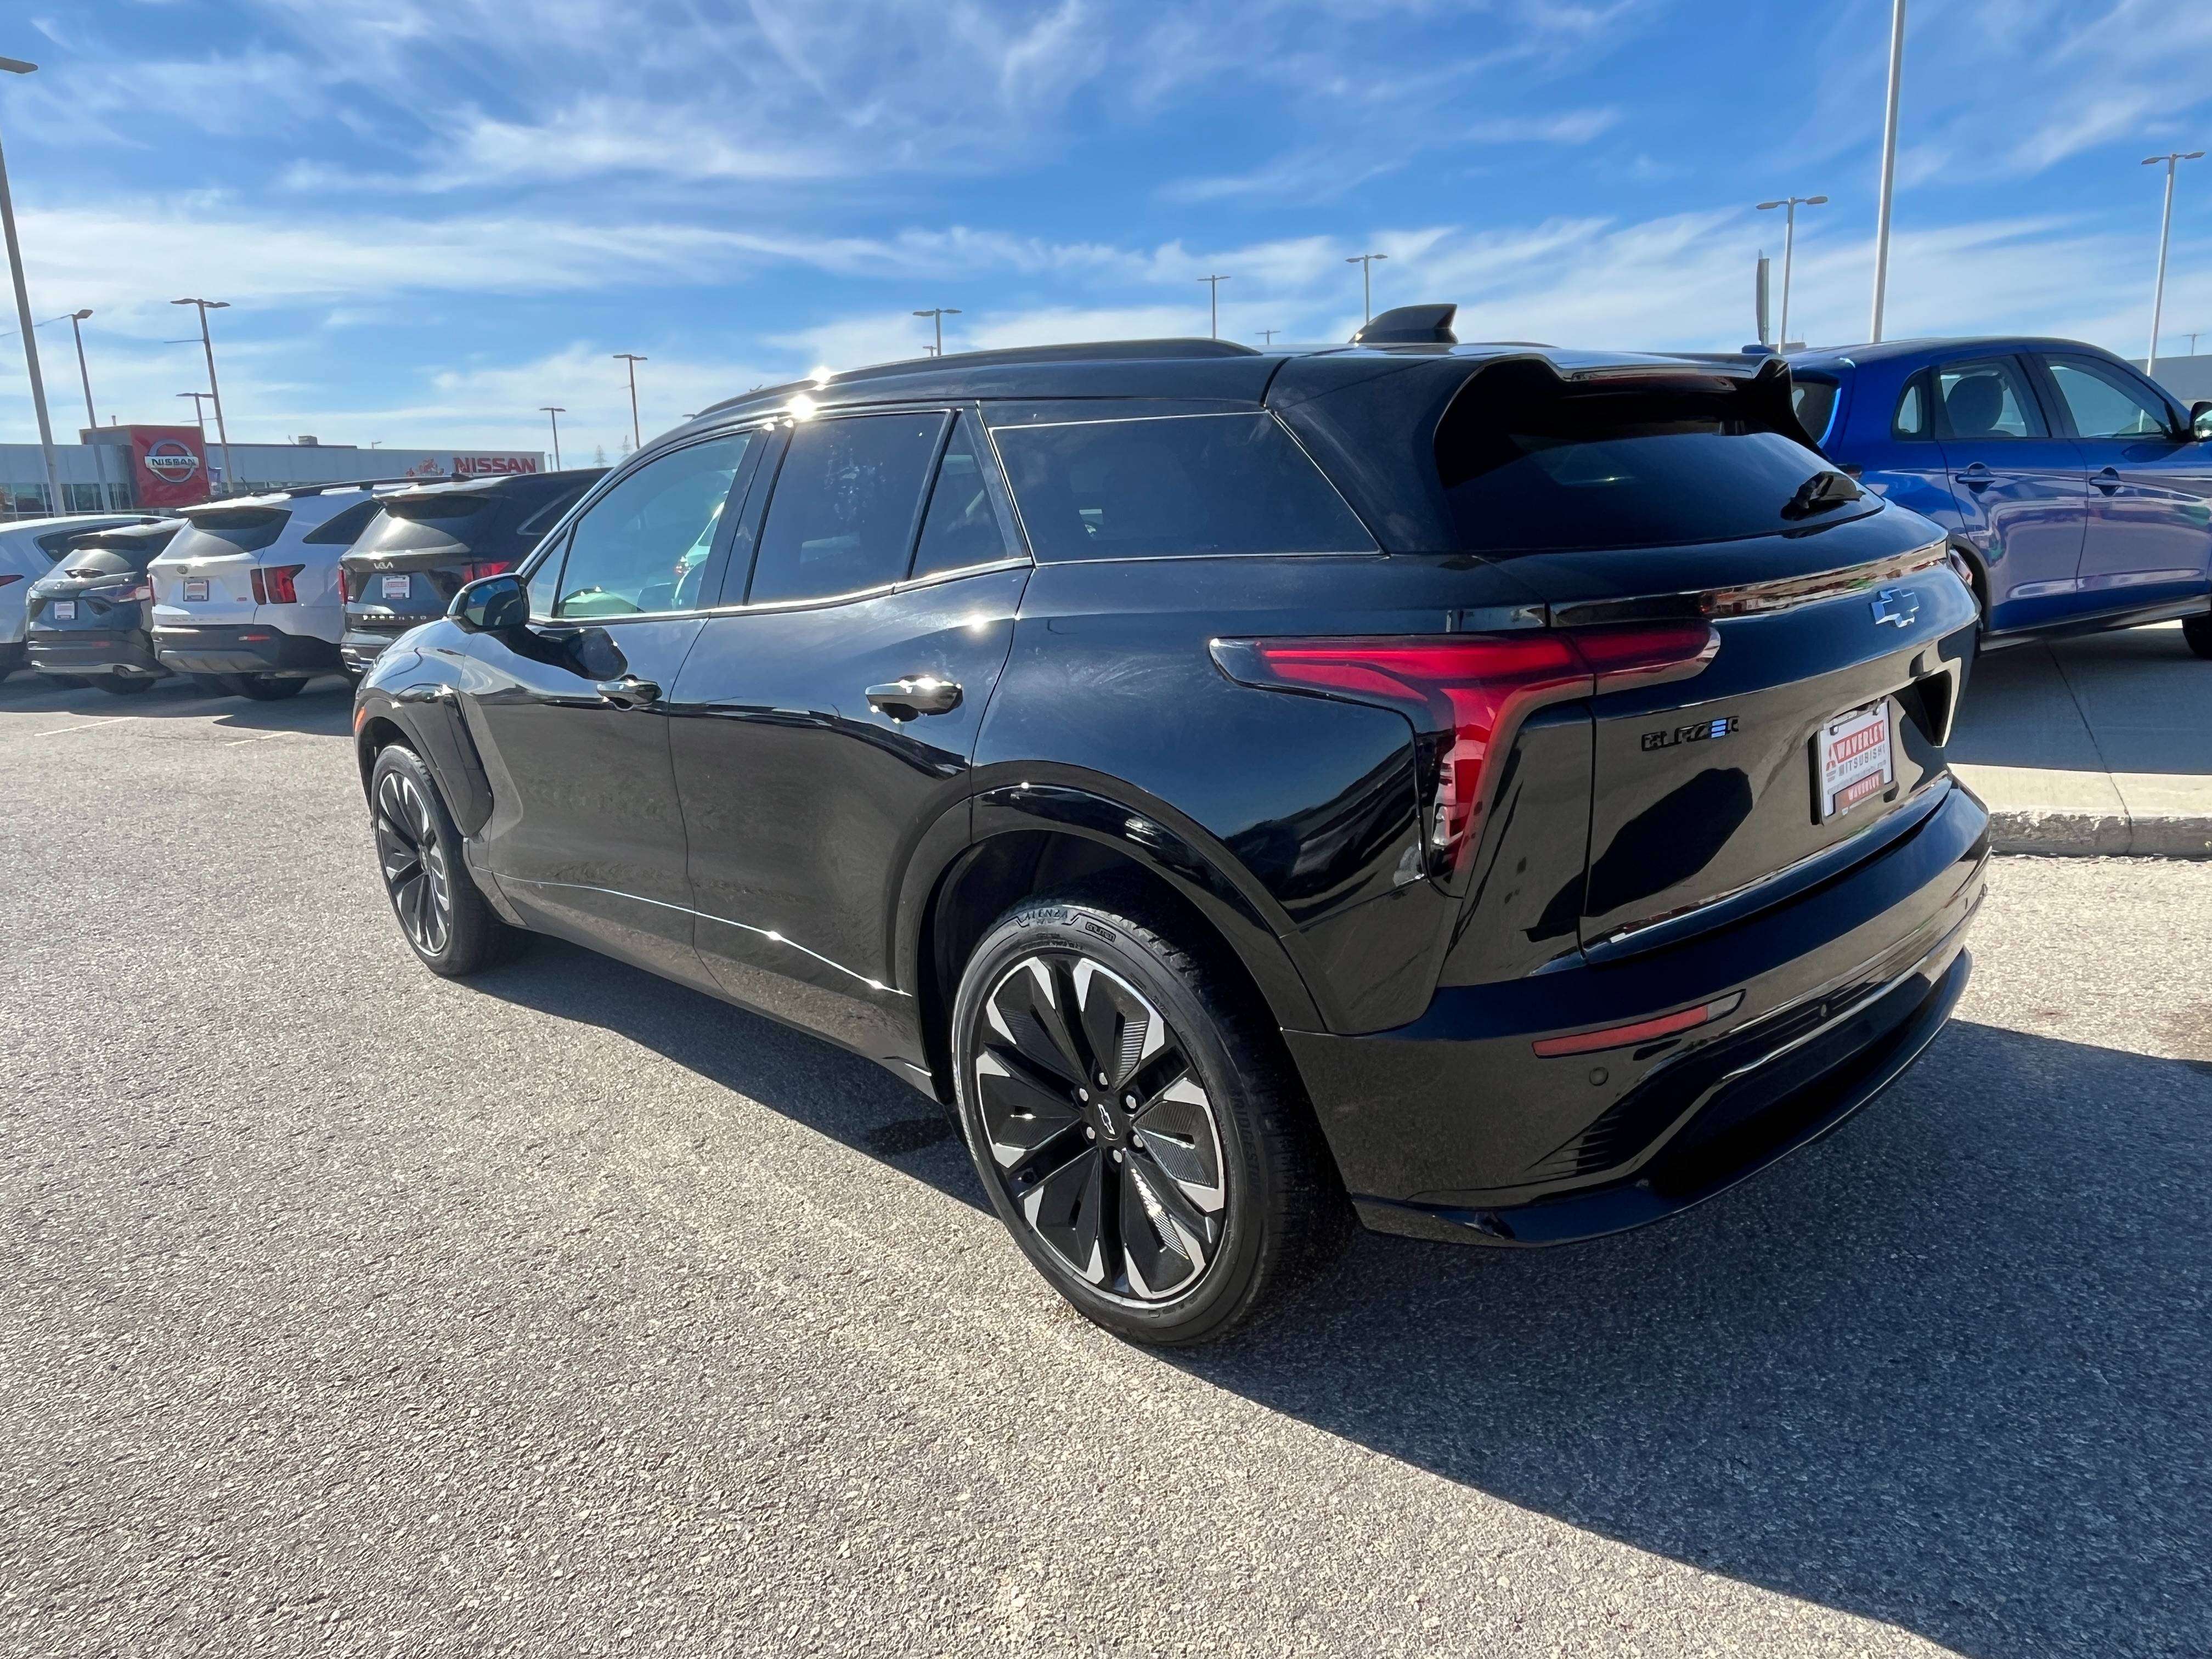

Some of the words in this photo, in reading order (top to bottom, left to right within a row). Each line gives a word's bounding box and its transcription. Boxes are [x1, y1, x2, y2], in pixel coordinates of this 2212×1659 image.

[453, 457, 536, 473] NISSAN
[1641, 715, 1739, 752] BLAZER
[1836, 721, 1884, 760] WAVERLEY
[1839, 744, 1886, 776] MITSUBISHI
